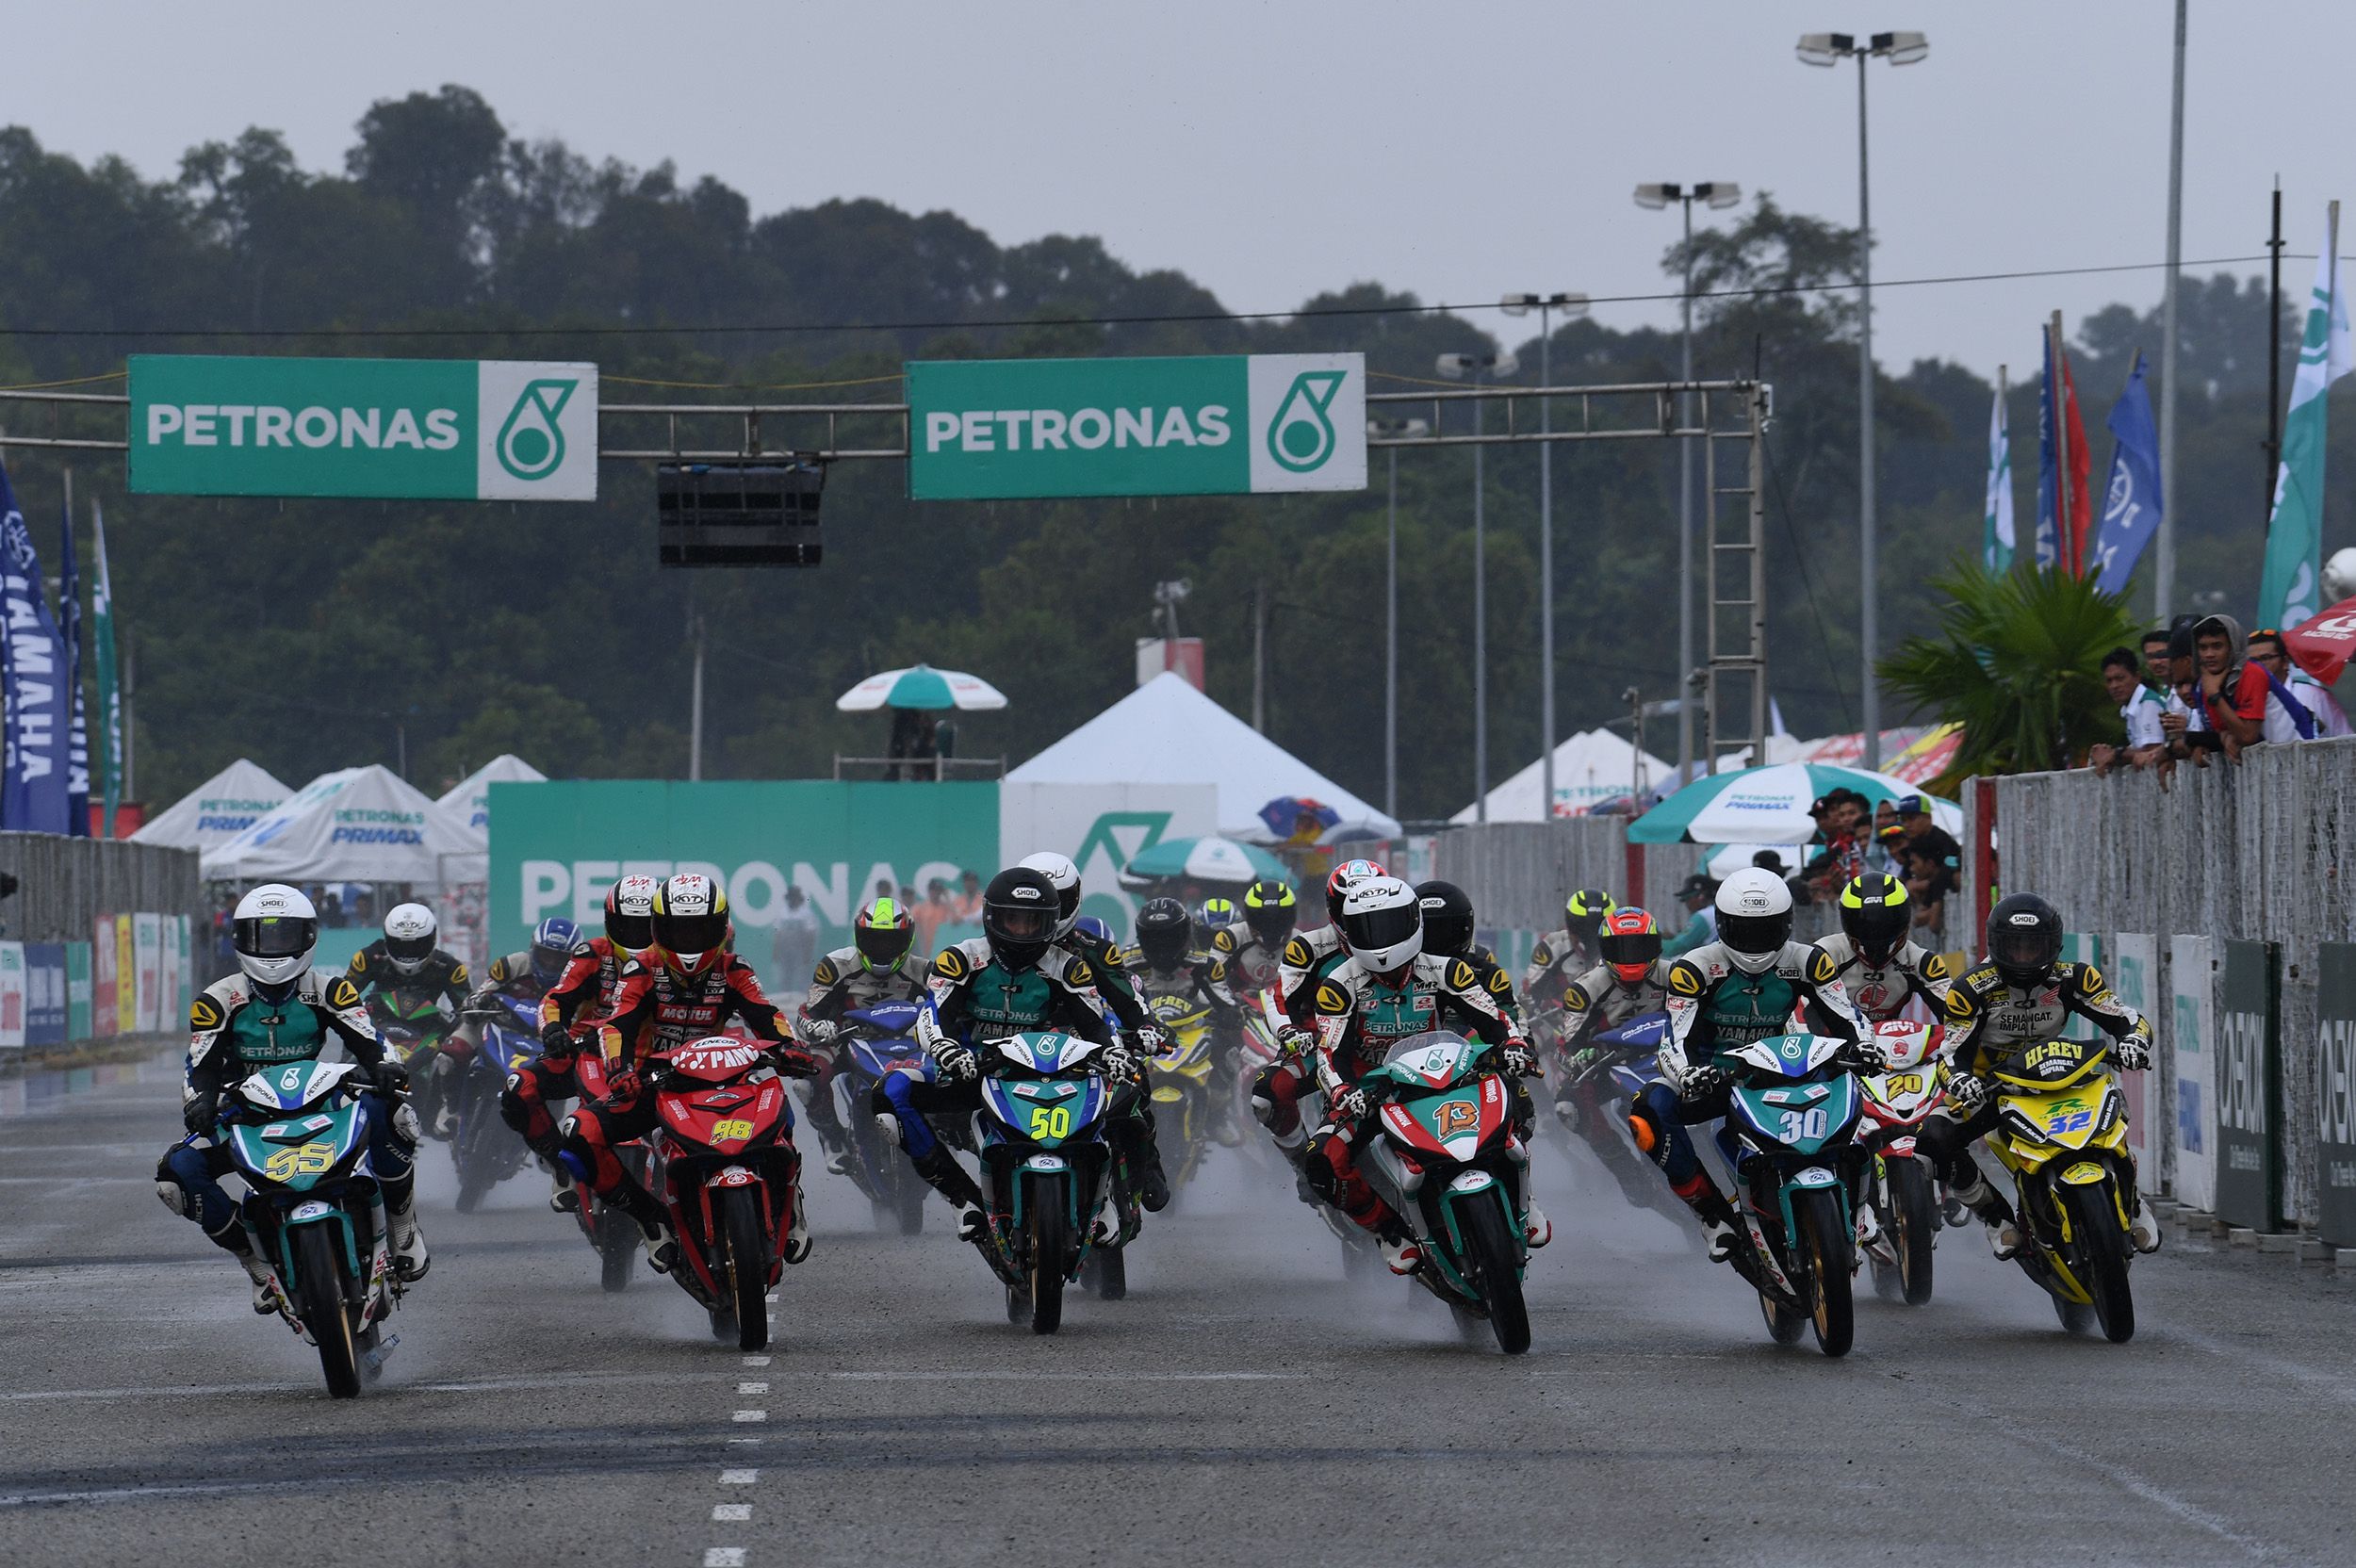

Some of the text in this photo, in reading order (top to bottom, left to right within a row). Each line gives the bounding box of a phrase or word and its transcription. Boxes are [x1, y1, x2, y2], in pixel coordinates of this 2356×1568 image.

[148, 404, 459, 449] PETRONAS
[926, 405, 1231, 452] PETRONAS
[1726, 802, 1791, 810] PRIMAX
[197, 815, 257, 832] PRIM
[335, 809, 424, 825] PETRONAS
[332, 825, 423, 845] PRIMAX
[626, 896, 649, 905] KYT
[677, 894, 702, 903] KYT
[1017, 889, 1038, 897] SHOEI
[1360, 888, 1386, 898] KYT
[1966, 966, 1998, 984] HI-REV
[662, 1008, 712, 1021] MOTUL
[973, 1005, 1040, 1021] PETRONAS
[1714, 1013, 1783, 1024] PETRONAS
[923, 1010, 936, 1042] PETRONA
[1365, 1021, 1429, 1033] PETRONAS
[1716, 1026, 1776, 1040] YAMAHA
[1879, 1021, 1915, 1035] GIVI
[240, 1043, 313, 1057] PETRONAS
[652, 1037, 681, 1053] YAM
[695, 1038, 738, 1047] ZENEOS
[711, 1044, 761, 1069] PANG
[2025, 1041, 2084, 1070] HI-REV
[307, 1070, 332, 1097] PETRONAS
[1886, 1073, 1923, 1103] 20
[1030, 1106, 1071, 1141] 50
[1433, 1101, 1479, 1135] 13
[1779, 1108, 1827, 1145] 30
[2046, 1111, 2092, 1135] 32
[709, 1119, 754, 1146] 98
[265, 1142, 335, 1184] 55
